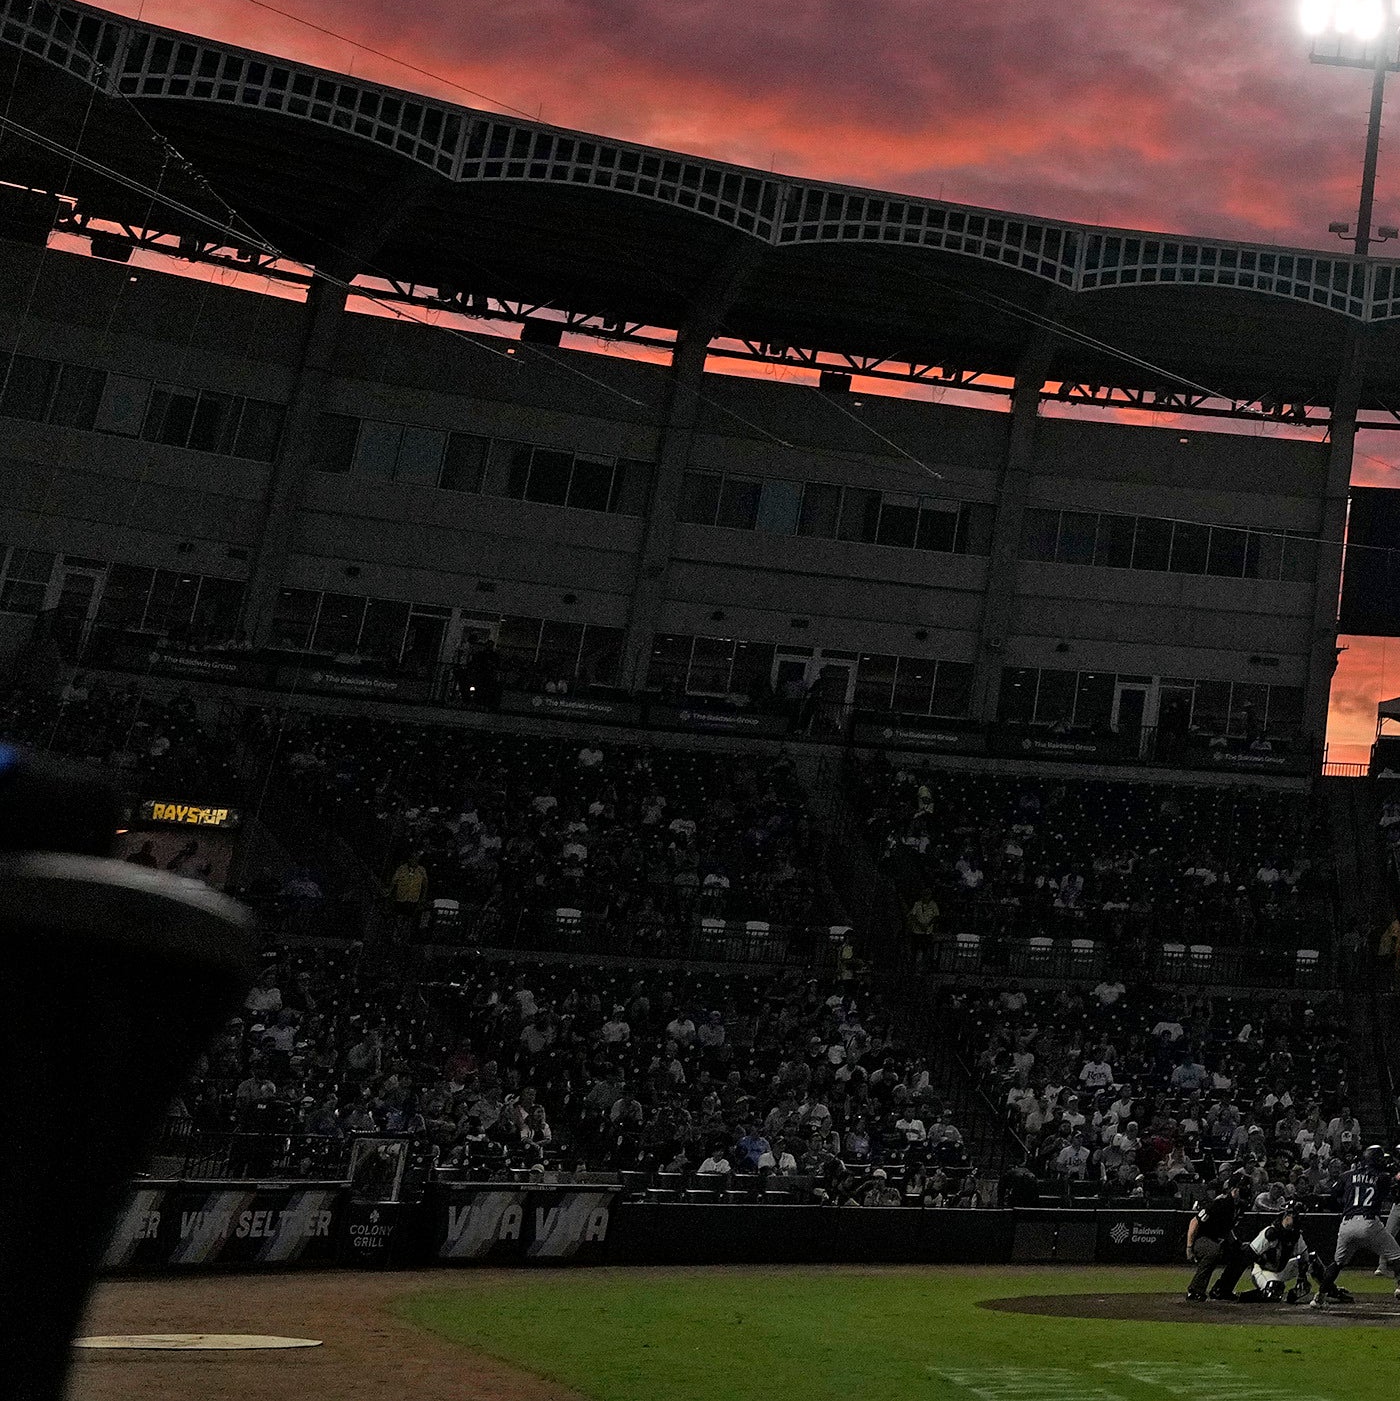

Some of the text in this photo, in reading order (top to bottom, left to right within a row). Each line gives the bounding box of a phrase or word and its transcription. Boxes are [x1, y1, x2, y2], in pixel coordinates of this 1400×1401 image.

[1353, 1186, 1375, 1207] 12
[236, 1210, 332, 1238] SELTER
[350, 1224, 393, 1236] COLONY
[353, 1236, 385, 1248] GRILL
[1131, 1235, 1157, 1244] Group
